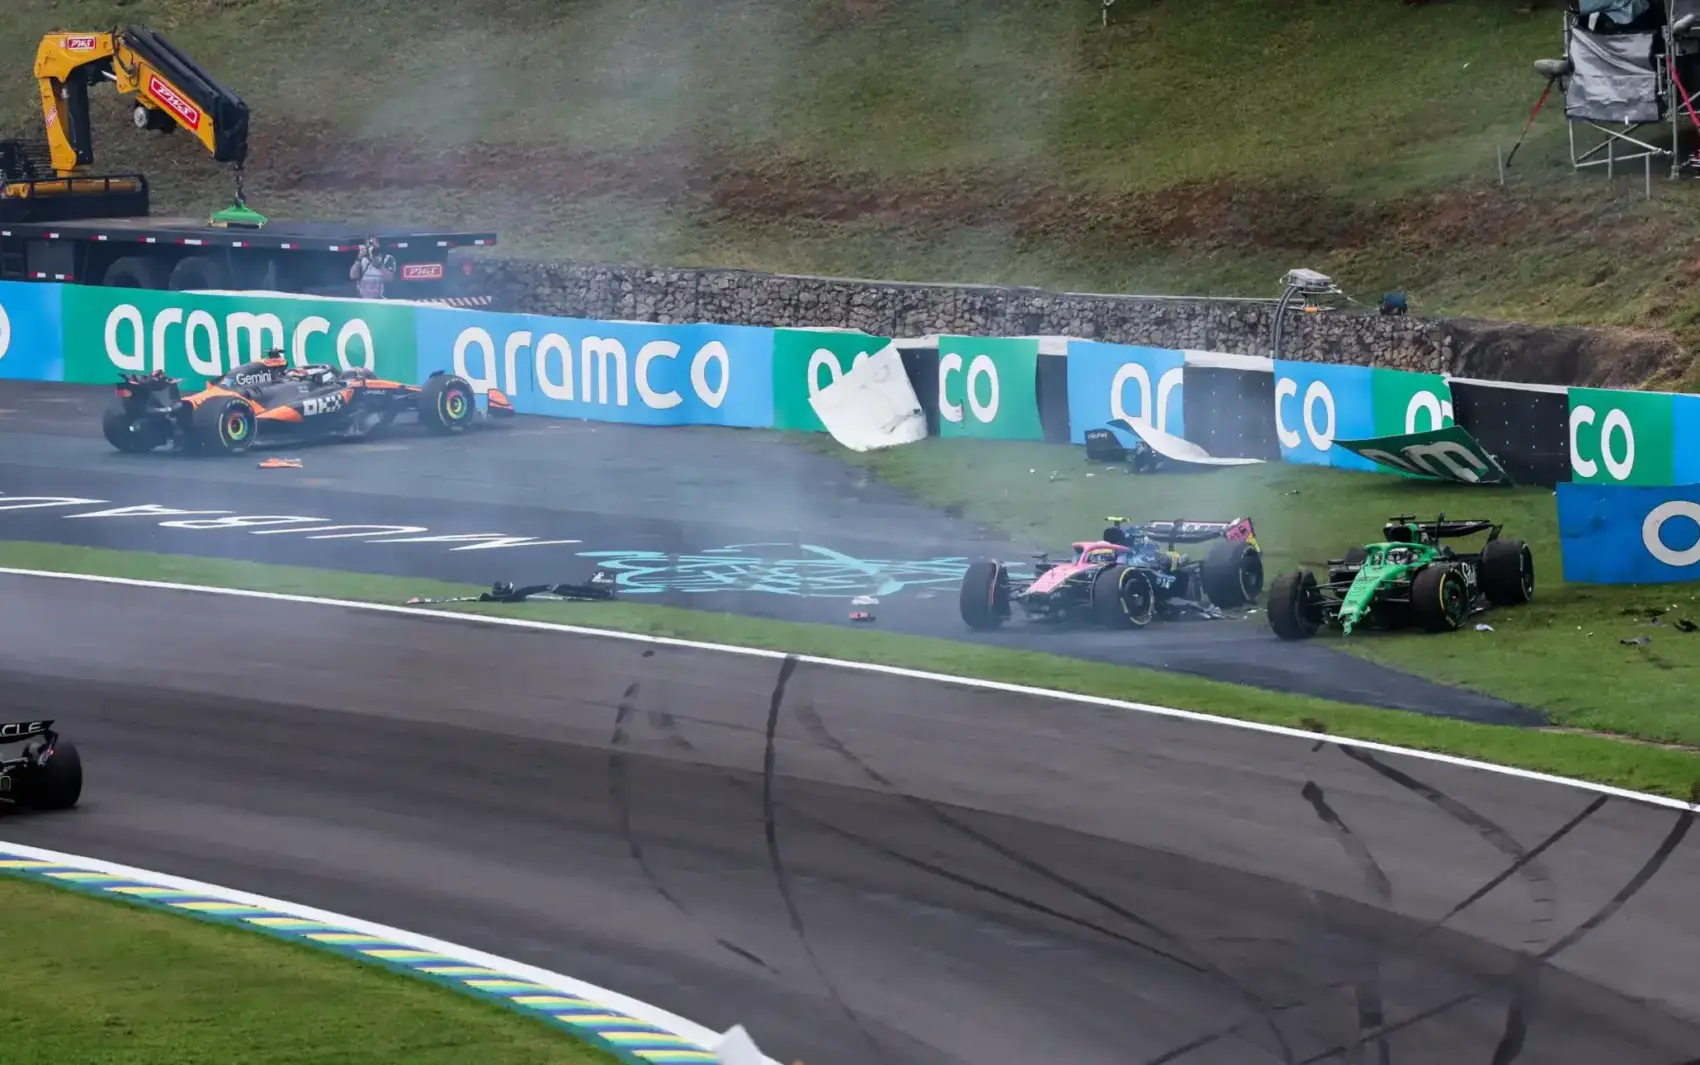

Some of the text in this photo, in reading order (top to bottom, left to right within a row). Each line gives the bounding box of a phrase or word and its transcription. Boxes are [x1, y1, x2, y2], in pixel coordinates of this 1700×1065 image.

[104, 303, 376, 376] aramco
[452, 326, 730, 410] aramco
[235, 369, 272, 386] Gemini
[1569, 404, 1635, 481] co
[0, 722, 46, 737] CLE
